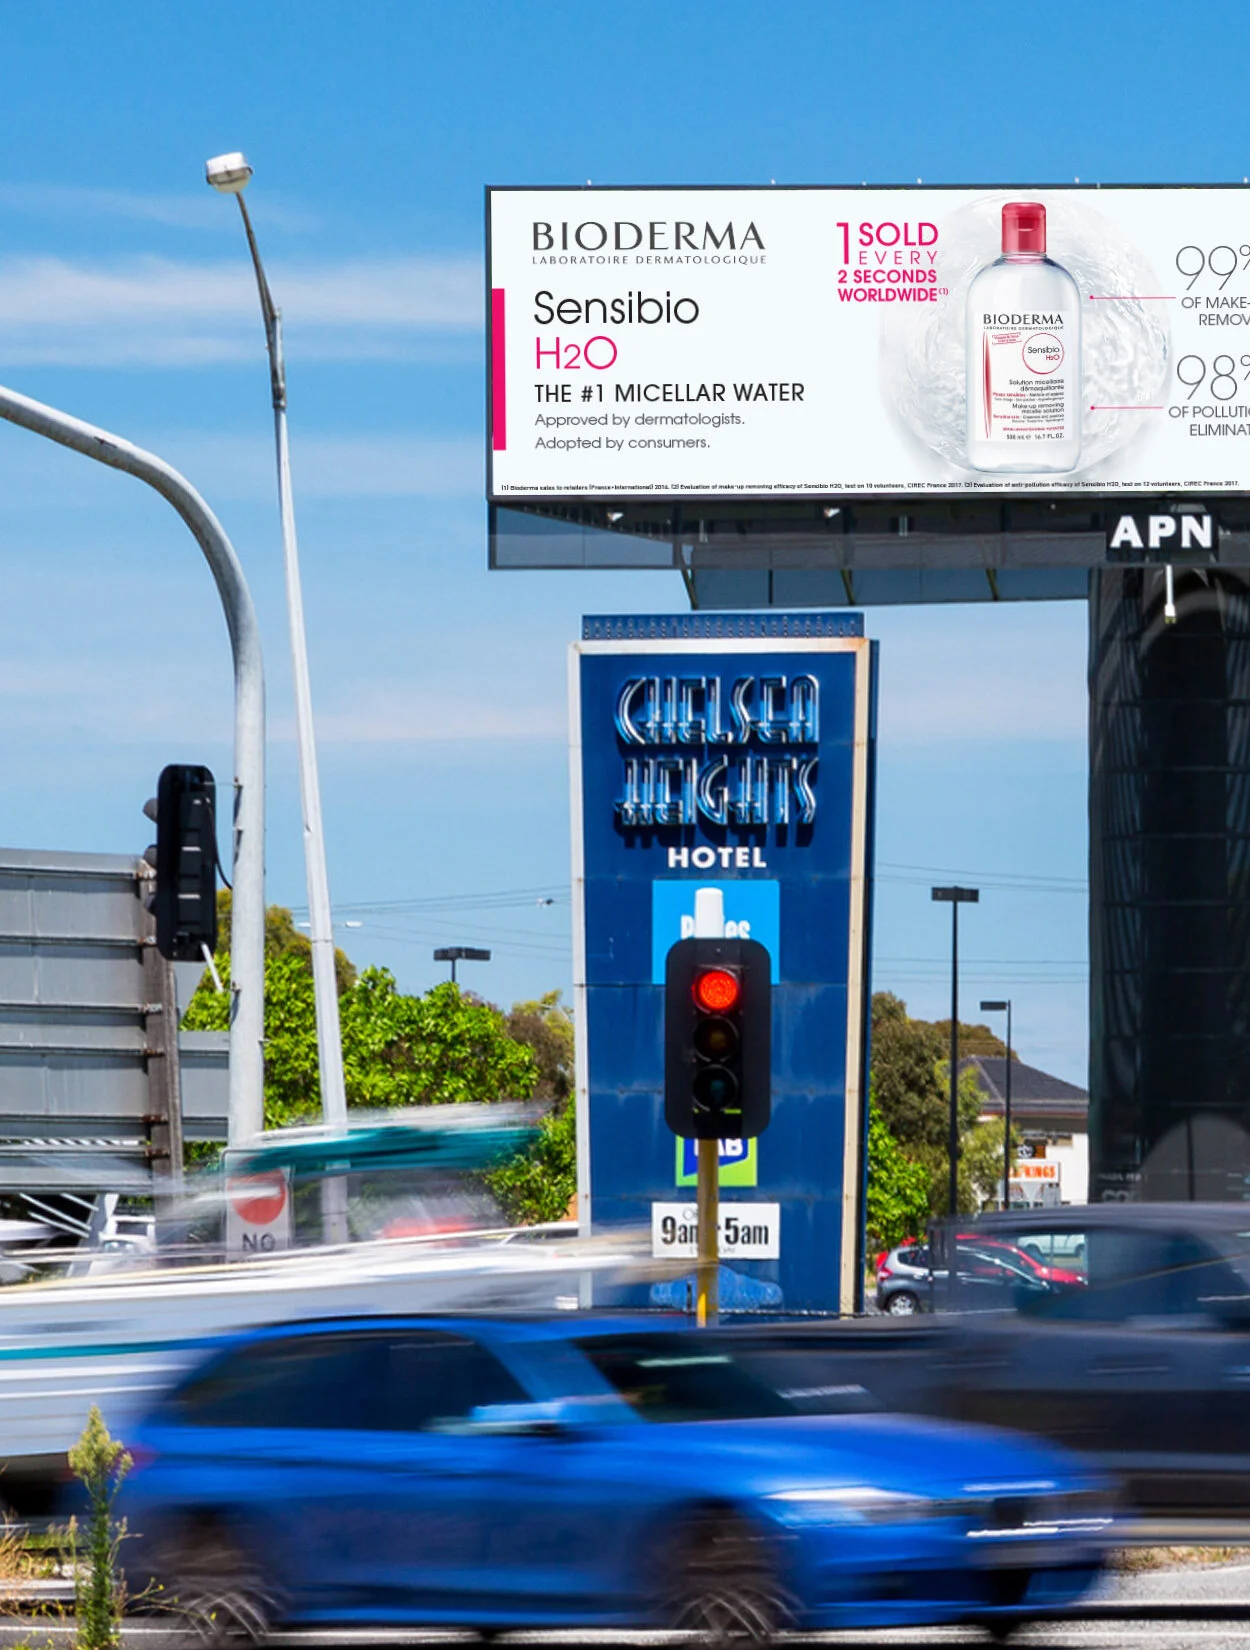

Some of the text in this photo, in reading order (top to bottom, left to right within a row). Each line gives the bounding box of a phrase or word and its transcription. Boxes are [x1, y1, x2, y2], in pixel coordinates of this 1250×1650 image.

[533, 222, 765, 250] BIODERMA
[837, 222, 938, 264] 1 SOLD
[533, 256, 765, 265] LABORATOIRE DERMATOLOGIQUE
[860, 251, 937, 265] EVERY
[838, 270, 937, 283] 2 SECONDS
[534, 291, 699, 324] Sensibio
[1181, 297, 1201, 308] OF
[984, 314, 1063, 324] BIODERMA
[536, 336, 617, 369] H2O
[1027, 346, 1060, 354] Sensibio
[535, 383, 804, 402] THE #1 MICELLAR WATER
[535, 413, 744, 428] Approved by dermatologists.
[1169, 406, 1189, 418] OF
[535, 437, 710, 451] Adopted by consumers.
[1109, 514, 1212, 548] APN
[612, 672, 820, 745] CHELSEA
[612, 754, 820, 826] HEIGHTS
[667, 846, 767, 869] HOTEL
[724, 1217, 769, 1245] 5am
[242, 1232, 276, 1252] NO
